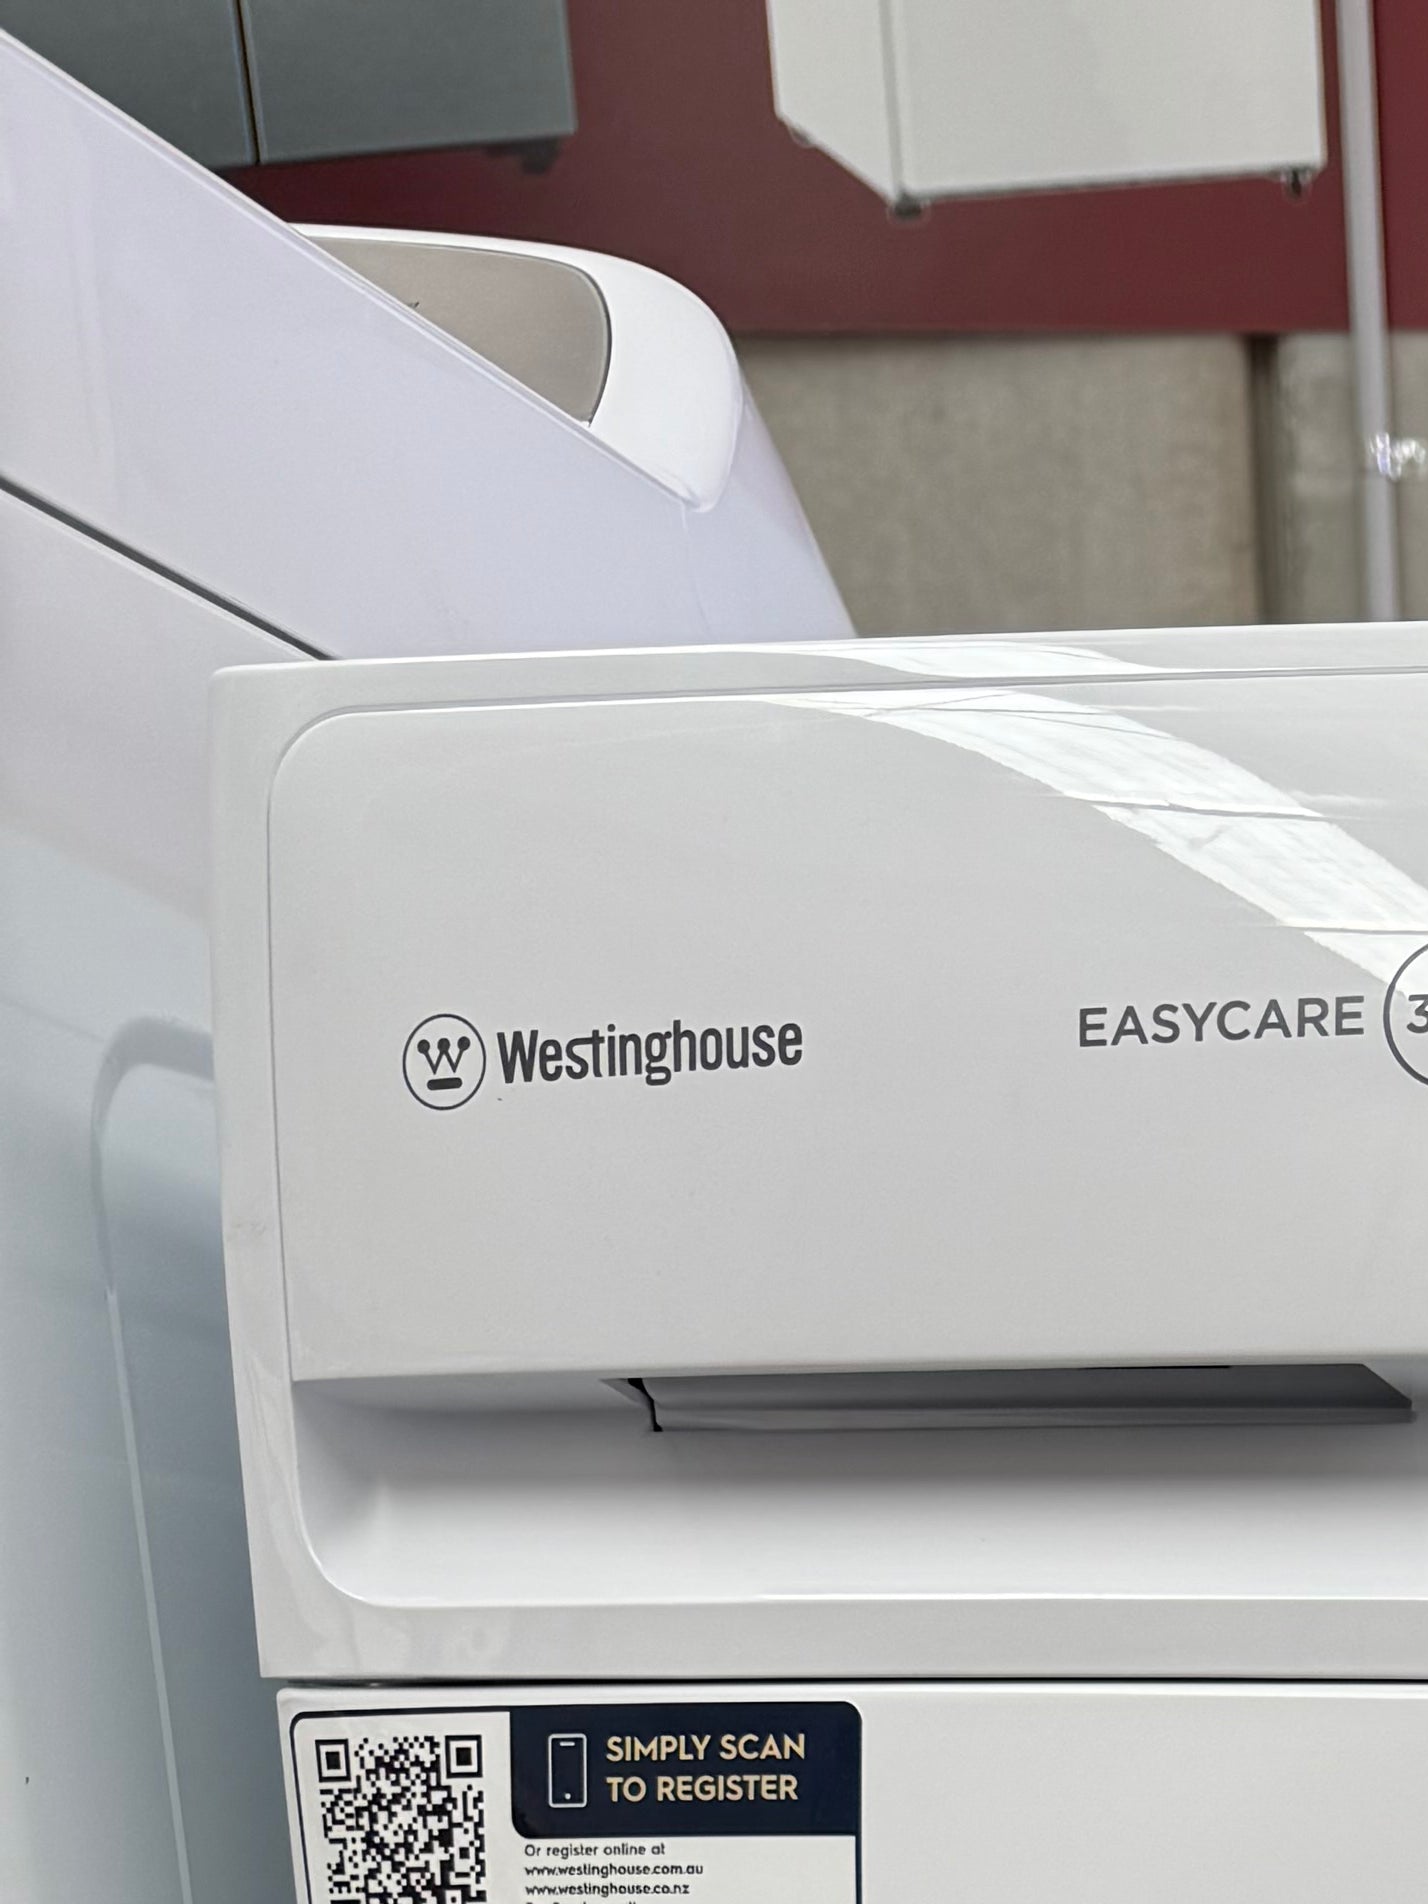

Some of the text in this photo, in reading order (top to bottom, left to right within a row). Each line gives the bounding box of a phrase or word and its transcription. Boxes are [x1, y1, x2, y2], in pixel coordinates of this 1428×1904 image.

[1078, 997, 1365, 1050] EASYCARE
[497, 1019, 803, 1087] Westinghouse
[606, 1734, 805, 1762] SIMPLY SCAN
[606, 1774, 798, 1802] TO REGISTER
[525, 1843, 665, 1859] Or register online at
[525, 1864, 703, 1878] www.westinghouse.com.au
[526, 1884, 690, 1897] www.westinghouse.co.nz
